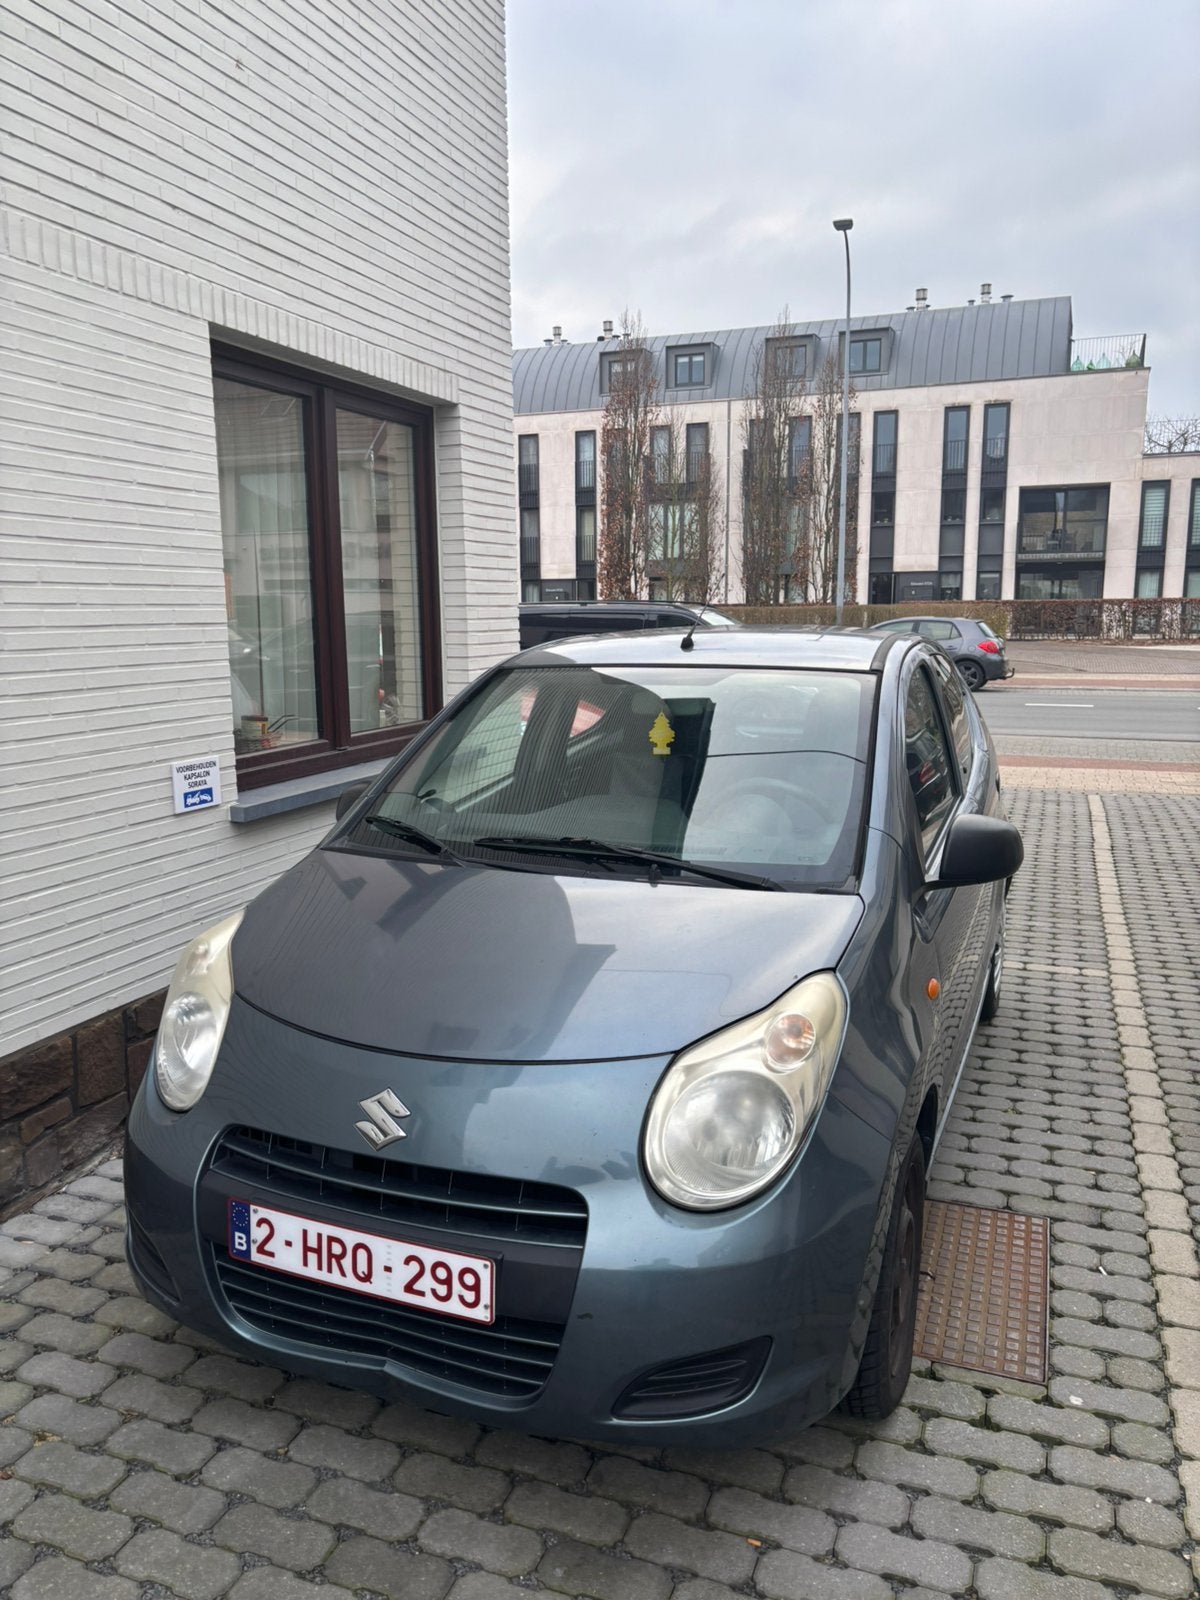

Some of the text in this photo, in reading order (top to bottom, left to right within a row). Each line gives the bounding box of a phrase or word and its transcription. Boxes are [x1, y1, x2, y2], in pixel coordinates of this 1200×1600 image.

[176, 761, 216, 773] VOORBEHOUDEN
[184, 770, 210, 781] KAPSALON
[188, 779, 207, 788] SORAYA
[234, 1231, 247, 1251] B
